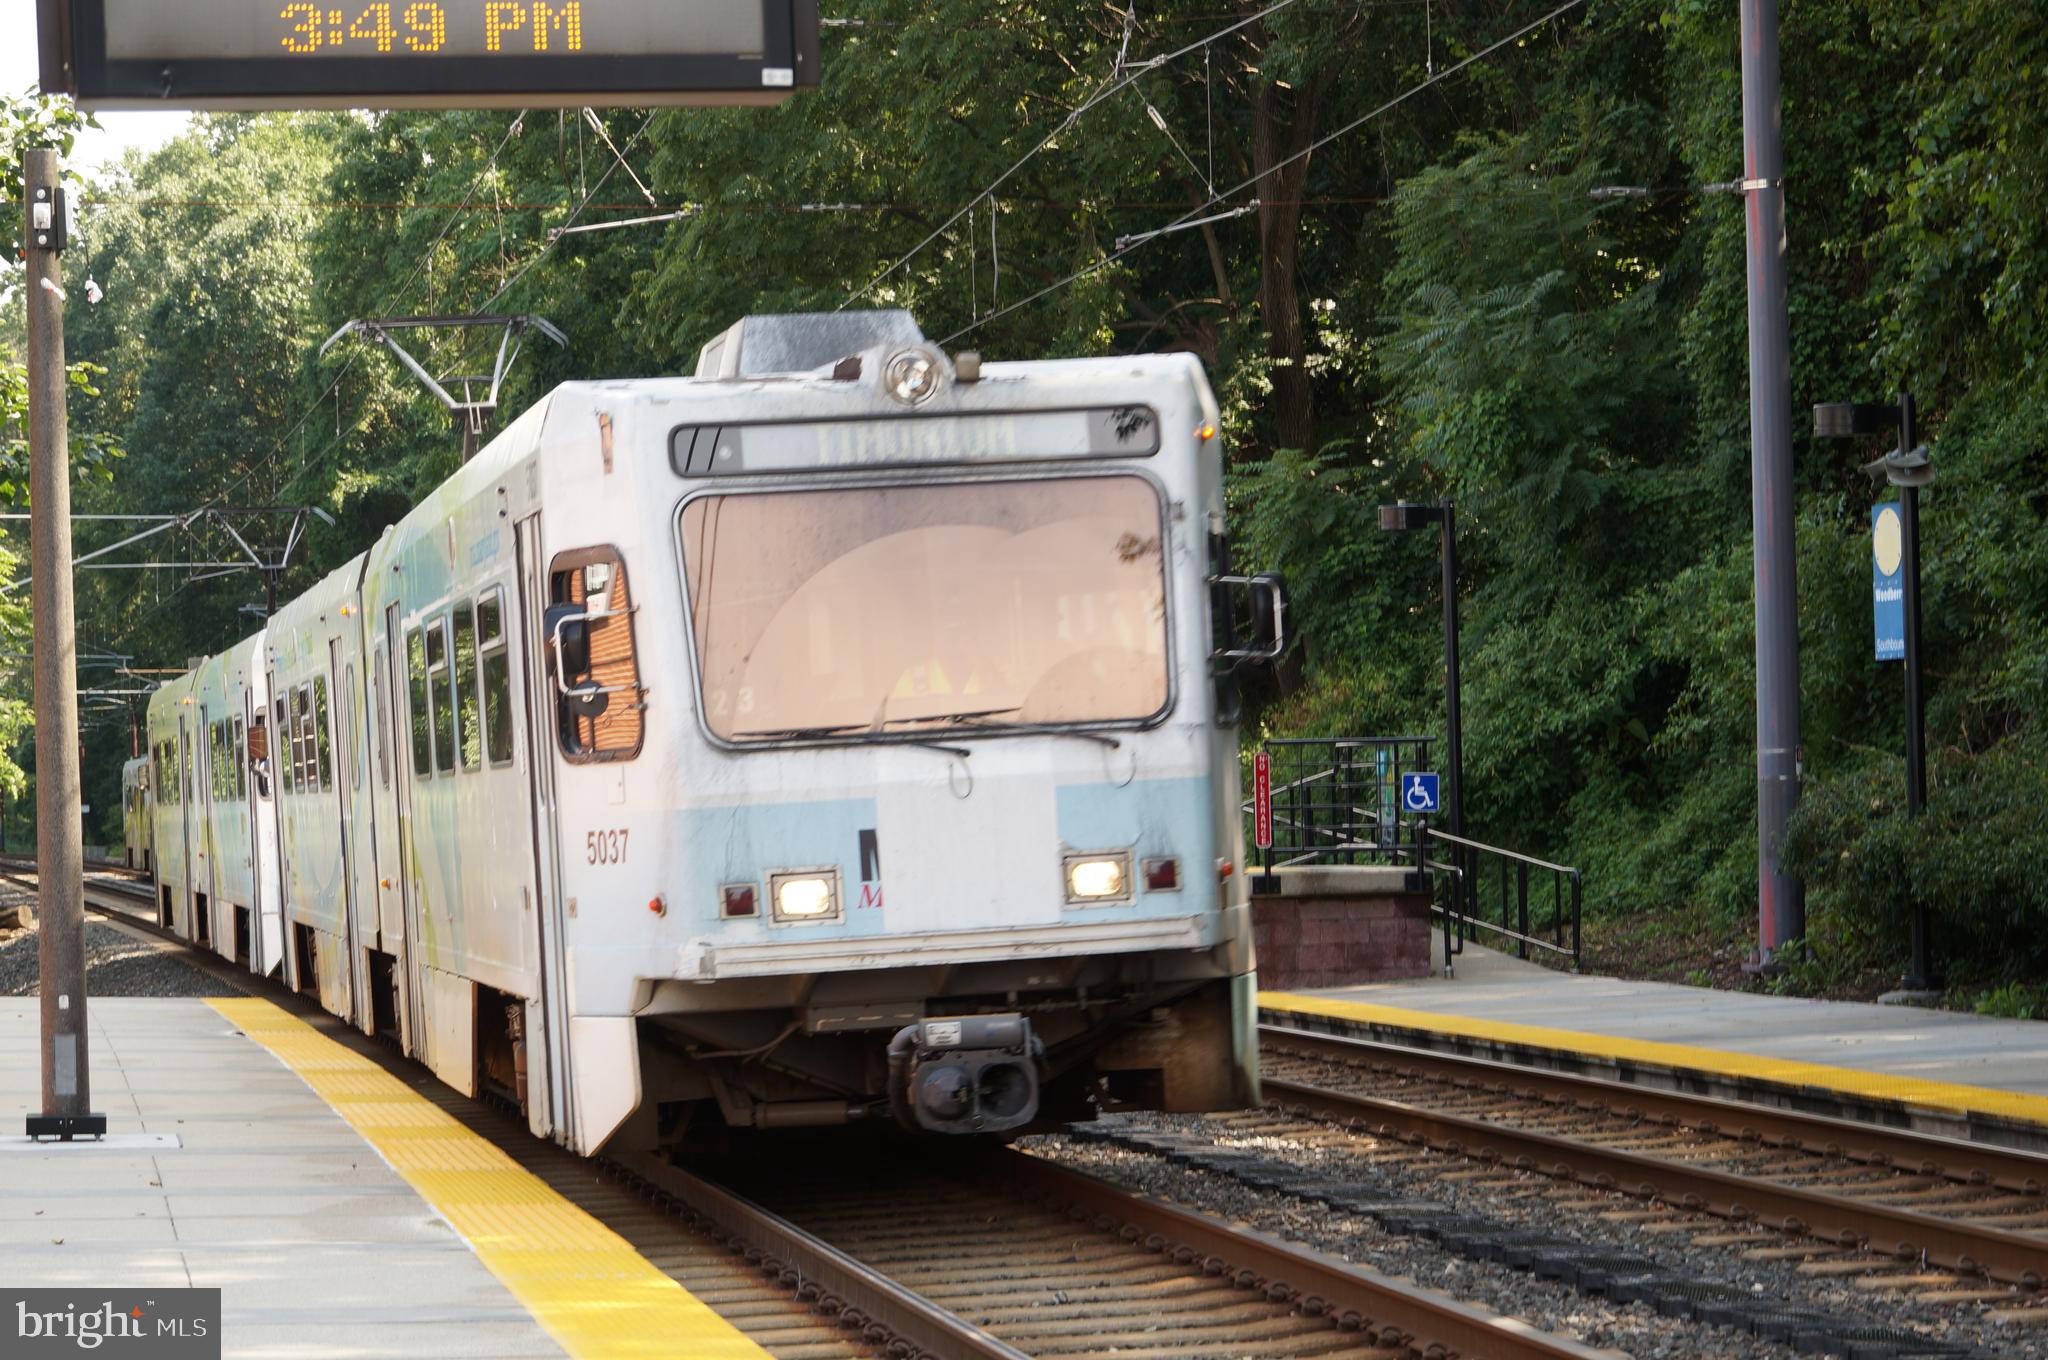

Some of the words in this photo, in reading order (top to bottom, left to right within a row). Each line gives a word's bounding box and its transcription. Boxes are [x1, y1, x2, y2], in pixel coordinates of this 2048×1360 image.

[280, 2, 446, 53] 3:49
[485, 1, 582, 51] PM
[1875, 588, 1903, 602] Woodberr
[1876, 637, 1904, 653] Southboun
[1259, 754, 1266, 771] NO
[586, 828, 629, 865] 5037
